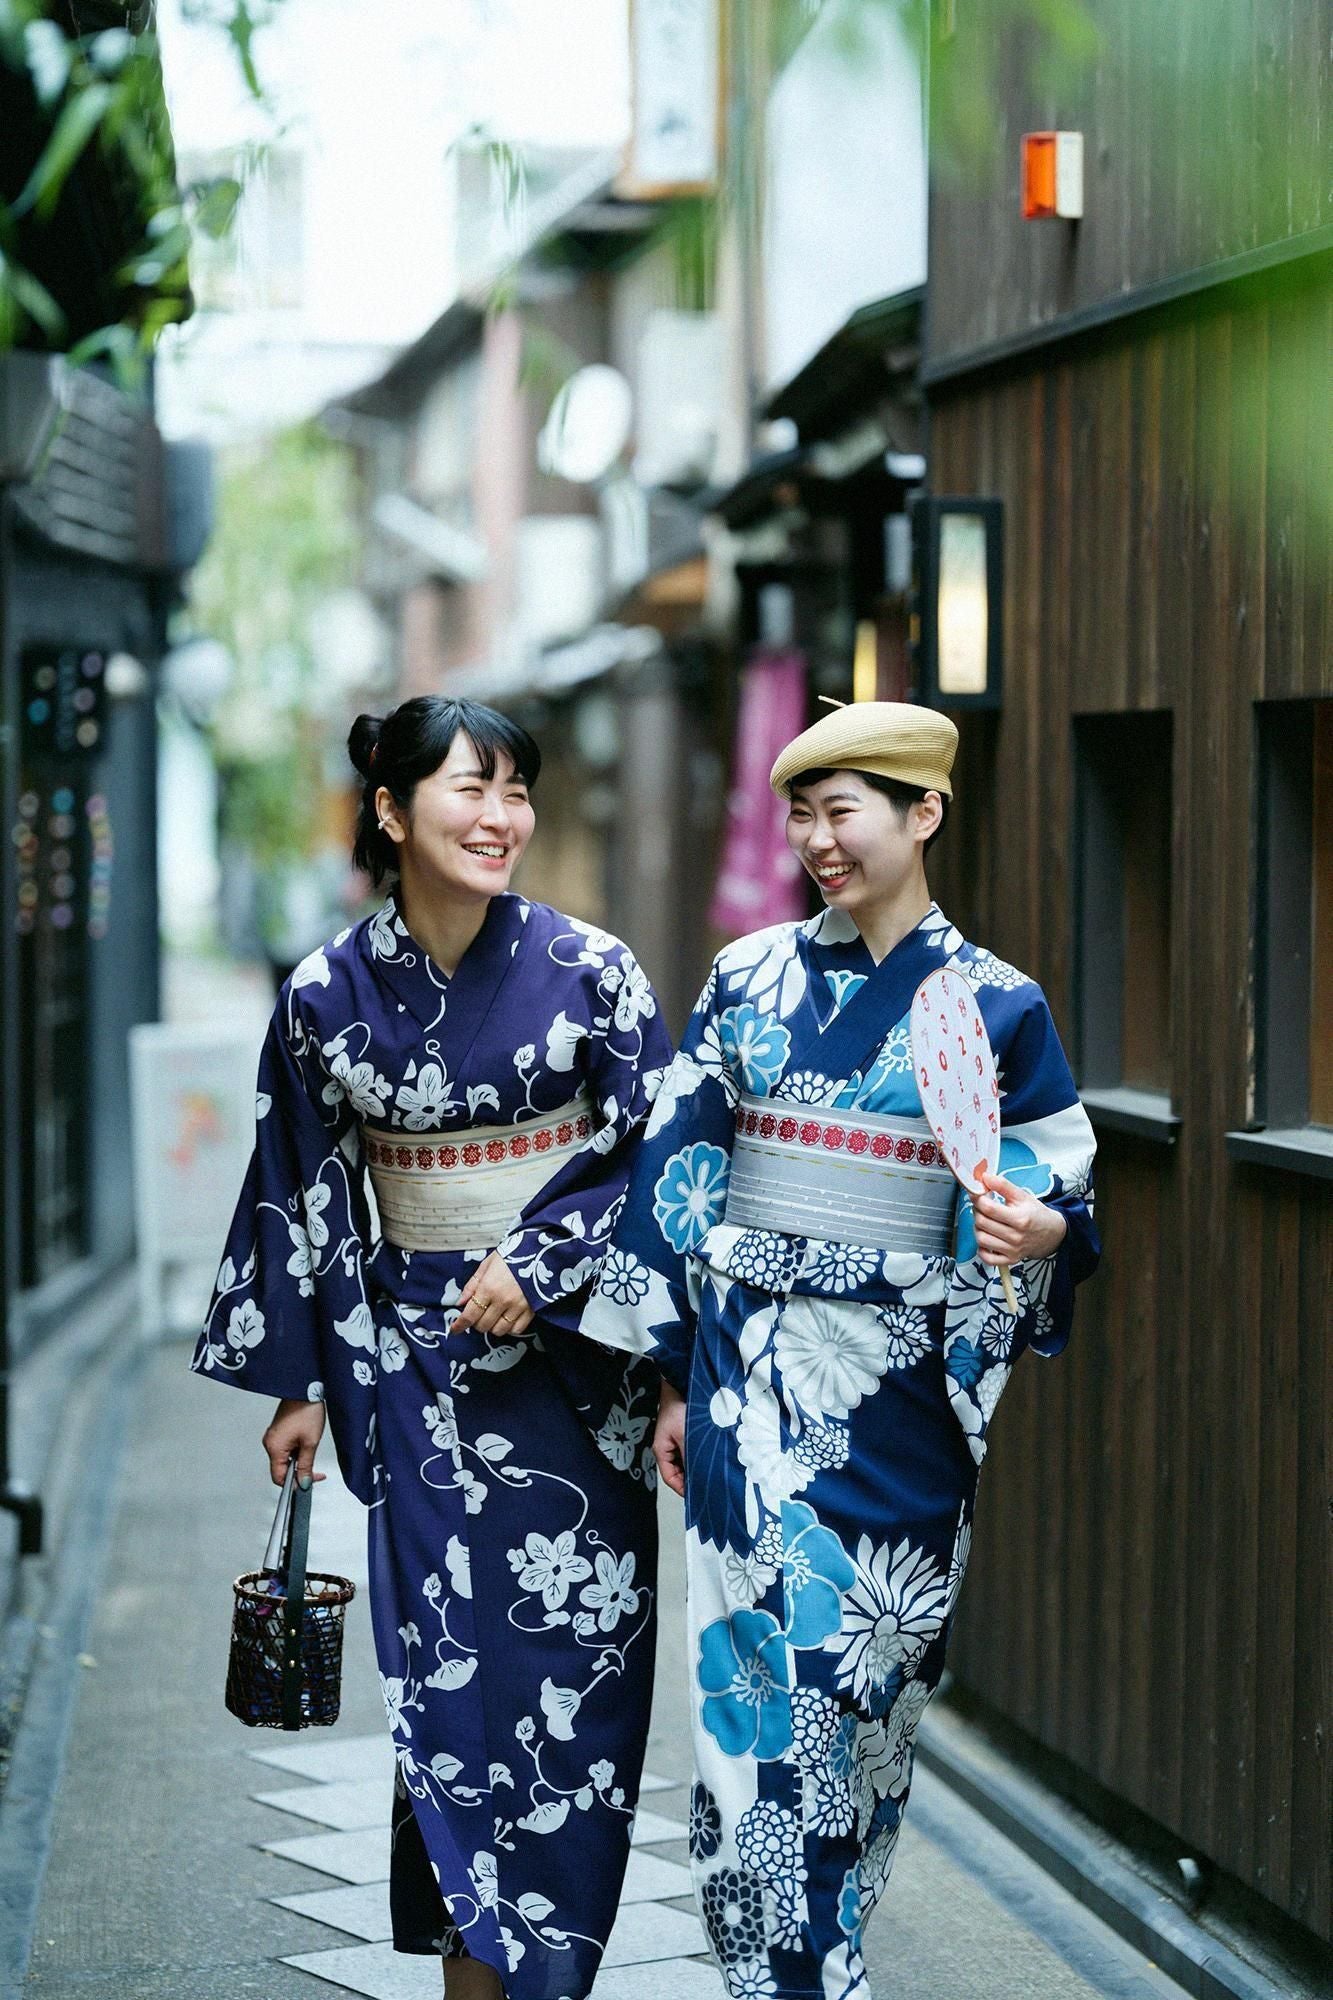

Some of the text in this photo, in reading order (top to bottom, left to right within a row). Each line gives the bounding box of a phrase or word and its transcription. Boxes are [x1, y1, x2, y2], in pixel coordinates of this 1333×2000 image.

[958, 1035, 967, 1056] 2
[975, 1055, 983, 1076] 9
[920, 1067, 930, 1088] 2
